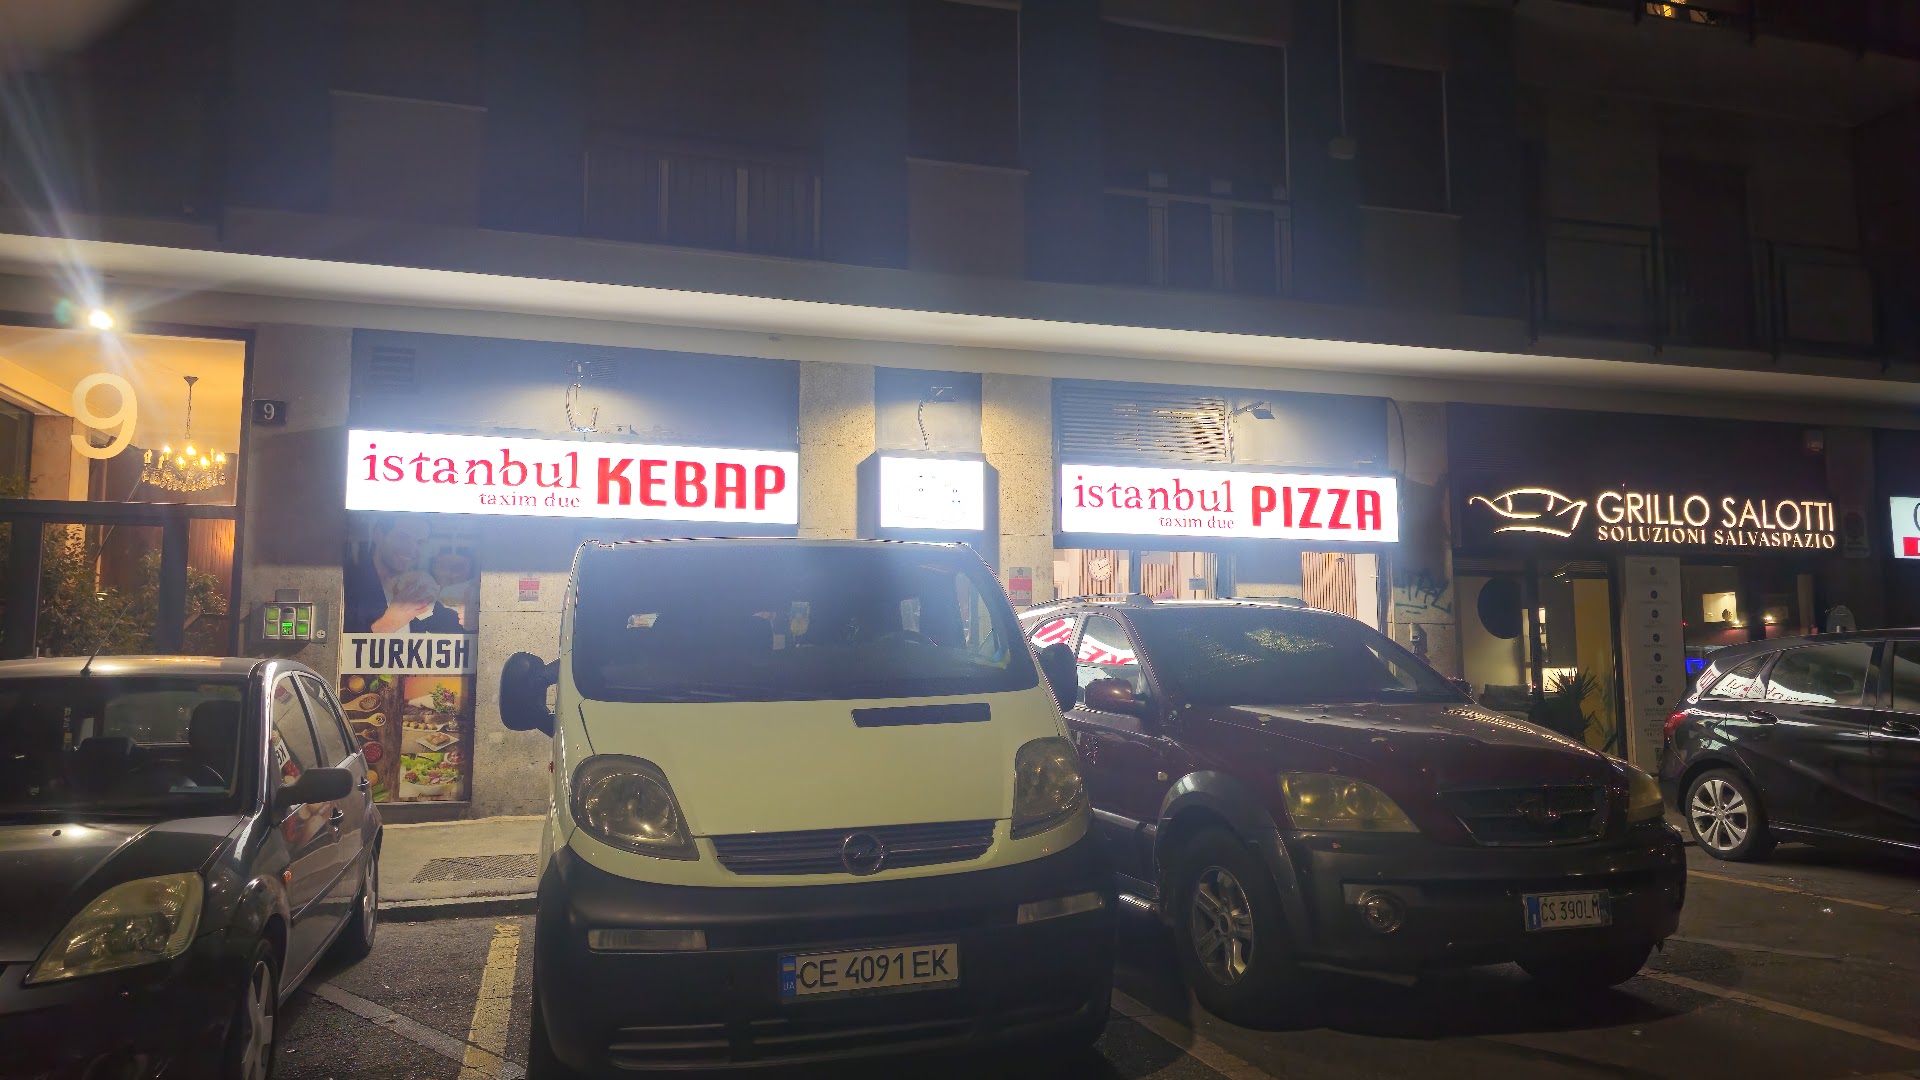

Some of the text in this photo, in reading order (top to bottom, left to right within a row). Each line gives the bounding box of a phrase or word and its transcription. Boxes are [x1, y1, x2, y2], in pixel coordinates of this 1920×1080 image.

[71, 373, 137, 459] 9
[263, 403, 275, 421] 9
[362, 443, 786, 511] istanbul KEBAP
[479, 491, 580, 508] taxim due
[1072, 475, 1382, 531] istanbul PIZZA
[1597, 491, 1835, 532] GRILLO SALOTTI
[1158, 515, 1234, 529] taxim due
[1598, 525, 1835, 549] SOLUZIONI SALVASPAZIO
[351, 638, 470, 669] TURKISH
[1541, 902, 1557, 921] CS
[800, 948, 949, 989] CE 4091 EK
[783, 981, 796, 990] UA
